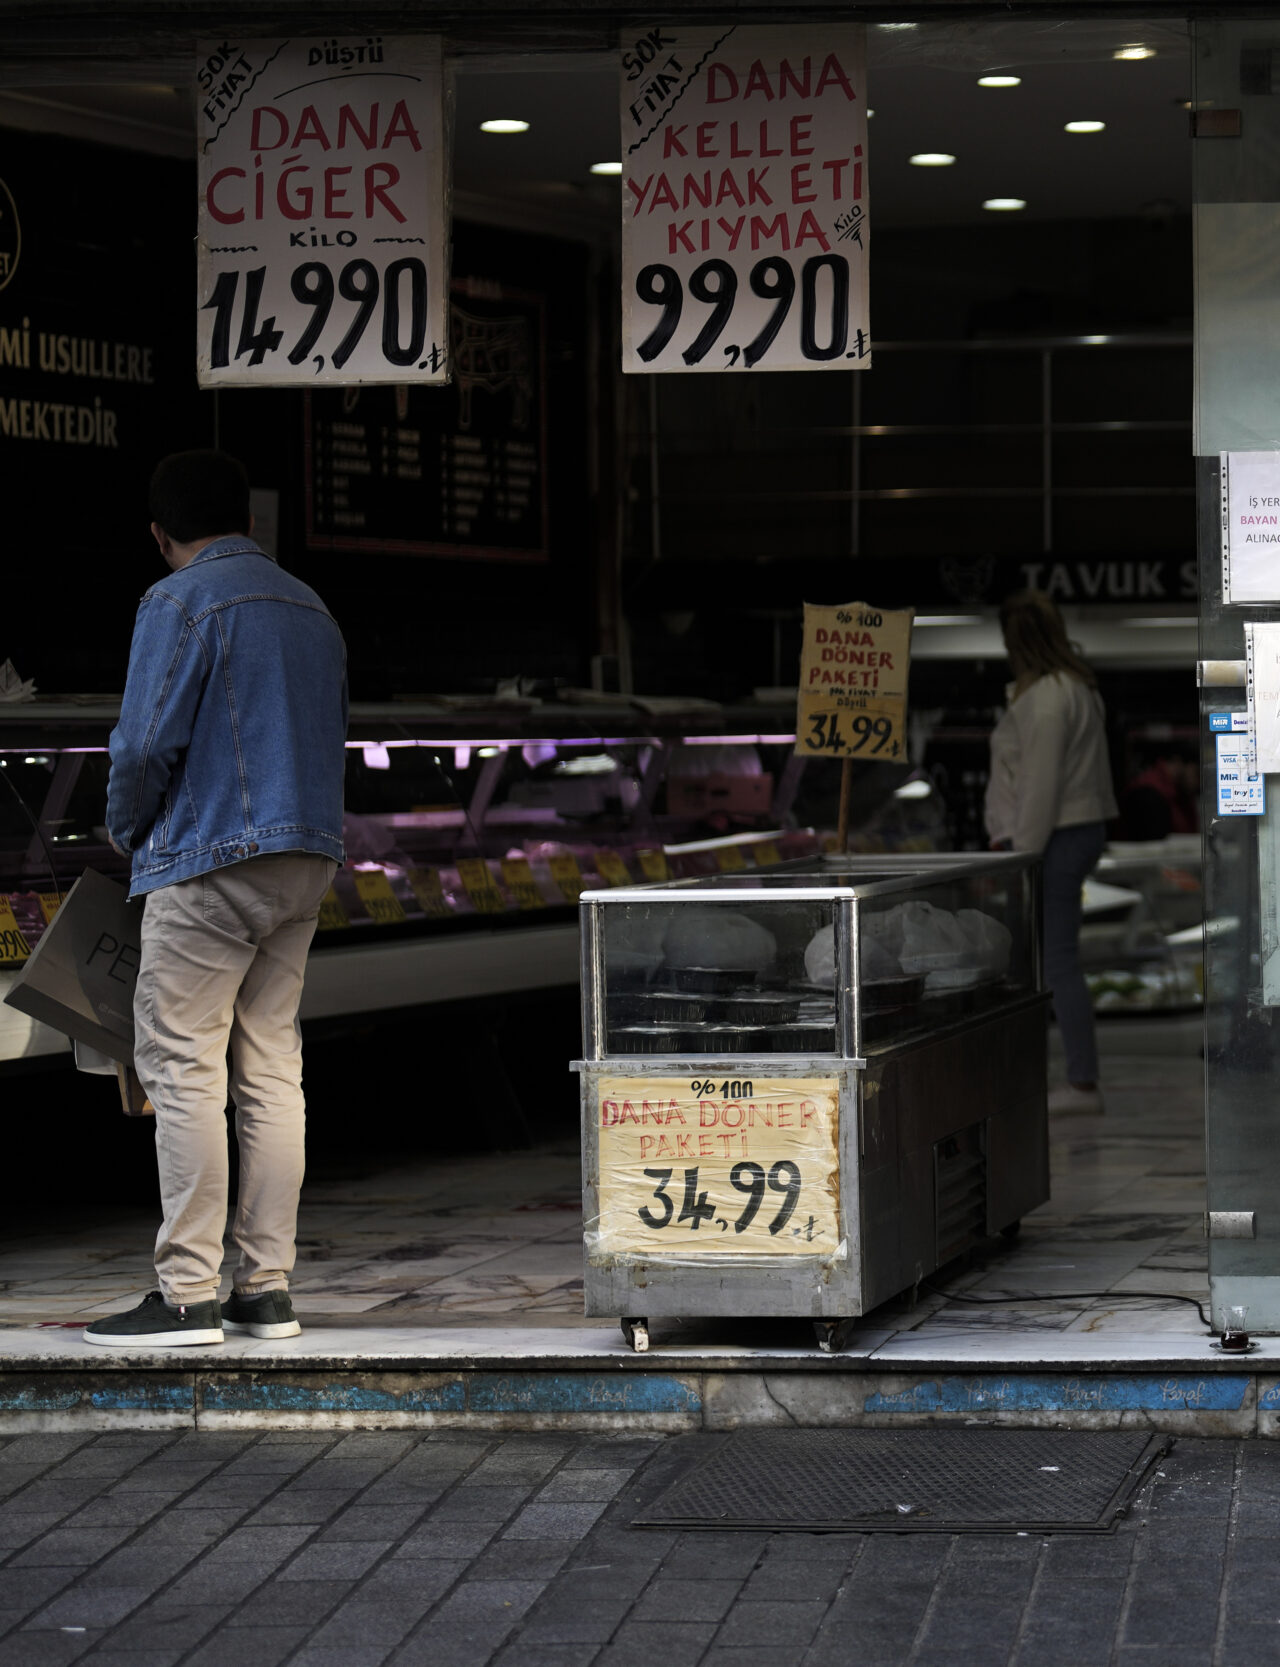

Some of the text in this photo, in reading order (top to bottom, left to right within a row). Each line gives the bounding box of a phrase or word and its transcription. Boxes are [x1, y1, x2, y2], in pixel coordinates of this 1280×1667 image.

[308, 37, 384, 71] DÜŞTÜ
[705, 53, 856, 104] DANA
[250, 100, 422, 152] DANA
[663, 114, 815, 159] KELLE
[206, 153, 407, 225] CİĞER
[627, 144, 863, 217] YANAK ETİ
[290, 227, 357, 247] KİLO
[668, 209, 831, 254] KIYMA
[38, 331, 155, 384] USULLERE
[1249, 495, 1258, 508] İŞ
[1240, 515, 1277, 525] BAYAN
[1019, 559, 1199, 598] TAVUK S
[815, 628, 874, 648] DANA
[821, 646, 894, 670] DÖNER
[809, 666, 879, 688] PAKETİ
[1220, 773, 1239, 781] MIR
[86, 932, 141, 985] PE
[602, 1098, 821, 1128] DANA DÖNER
[640, 1129, 748, 1159] PAKETİ
